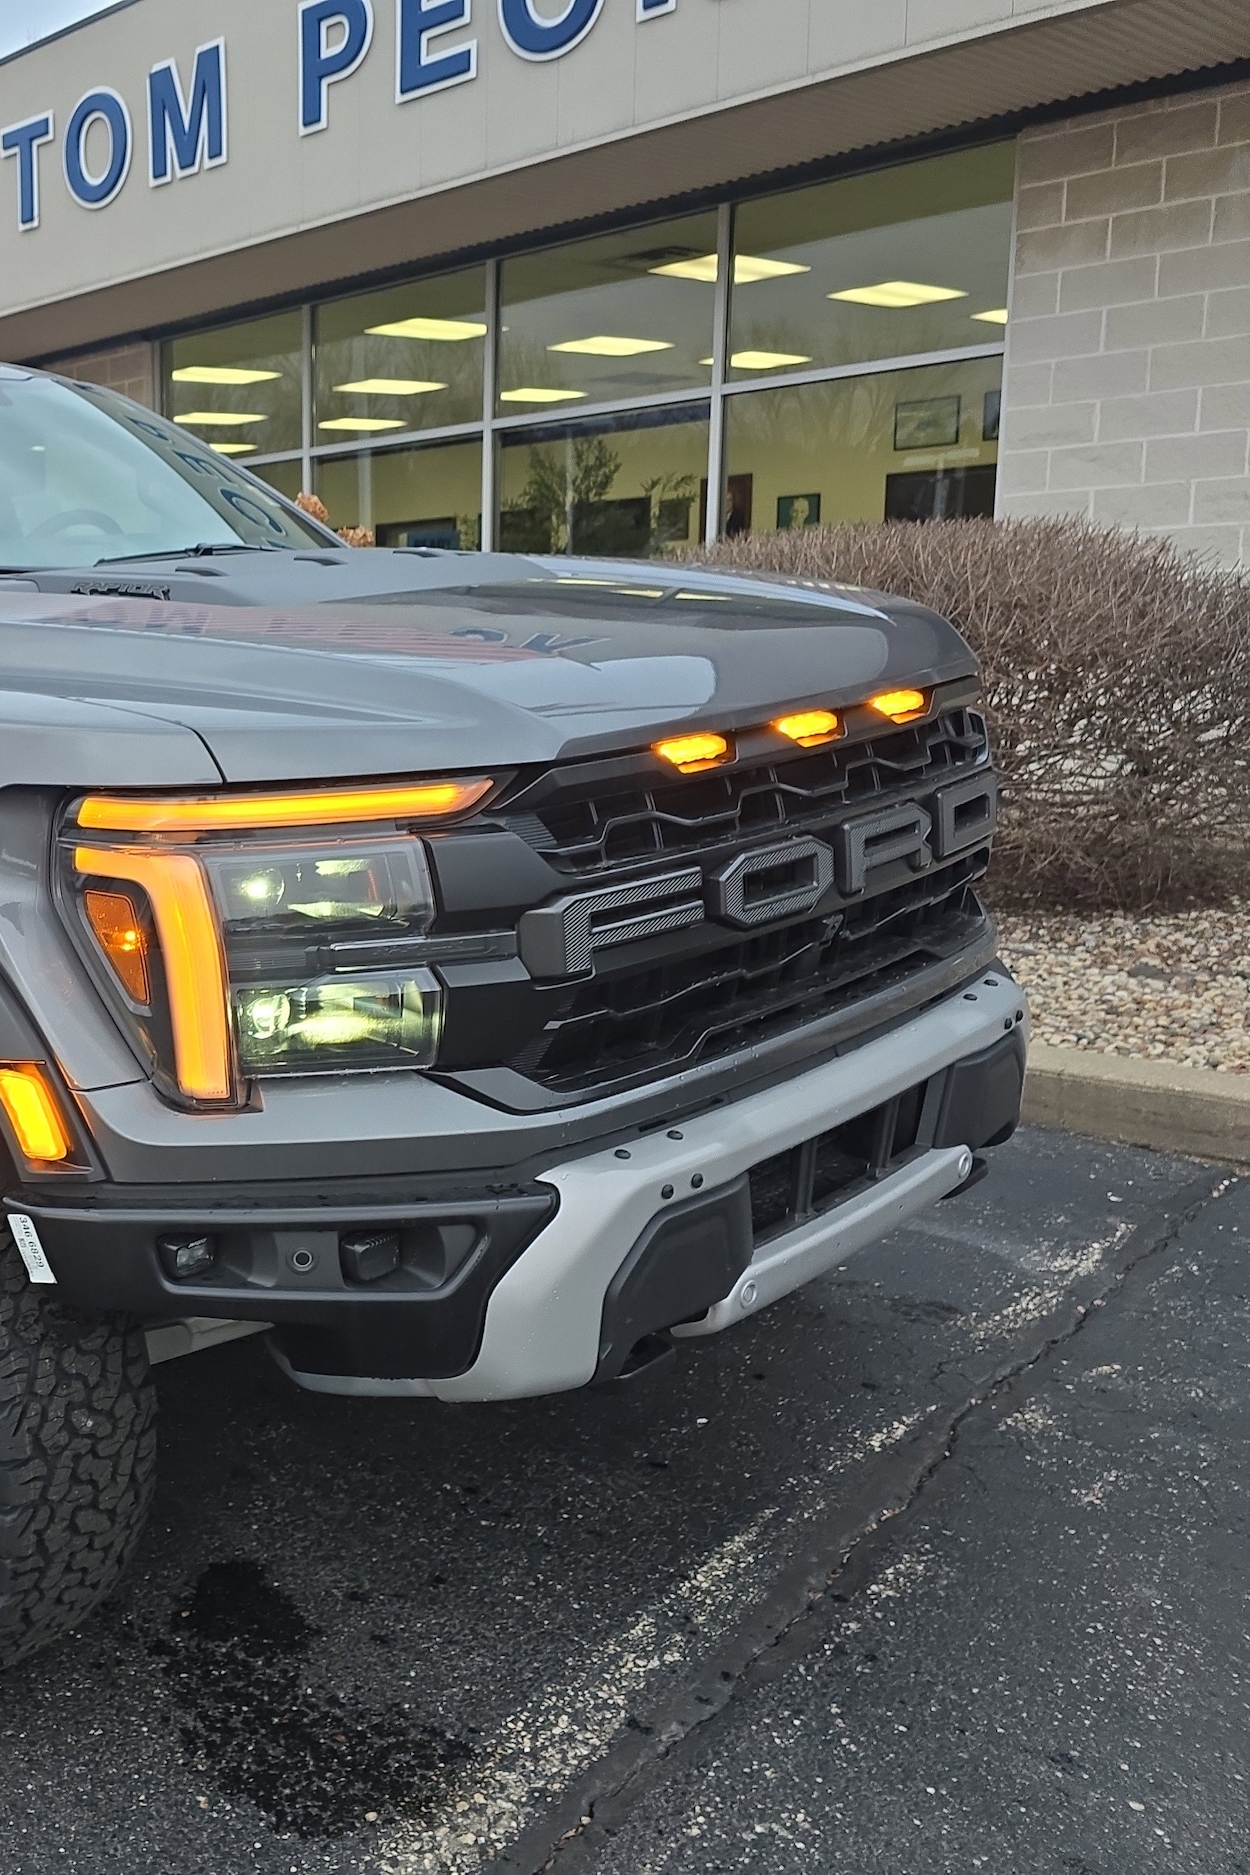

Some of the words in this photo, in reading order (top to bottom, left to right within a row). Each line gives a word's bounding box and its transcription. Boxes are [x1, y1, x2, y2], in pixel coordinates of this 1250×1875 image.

[0, 36, 228, 232] TOM
[298, 0, 678, 137] PE
[70, 582, 171, 600] RAPTOR
[520, 774, 997, 982] FORD
